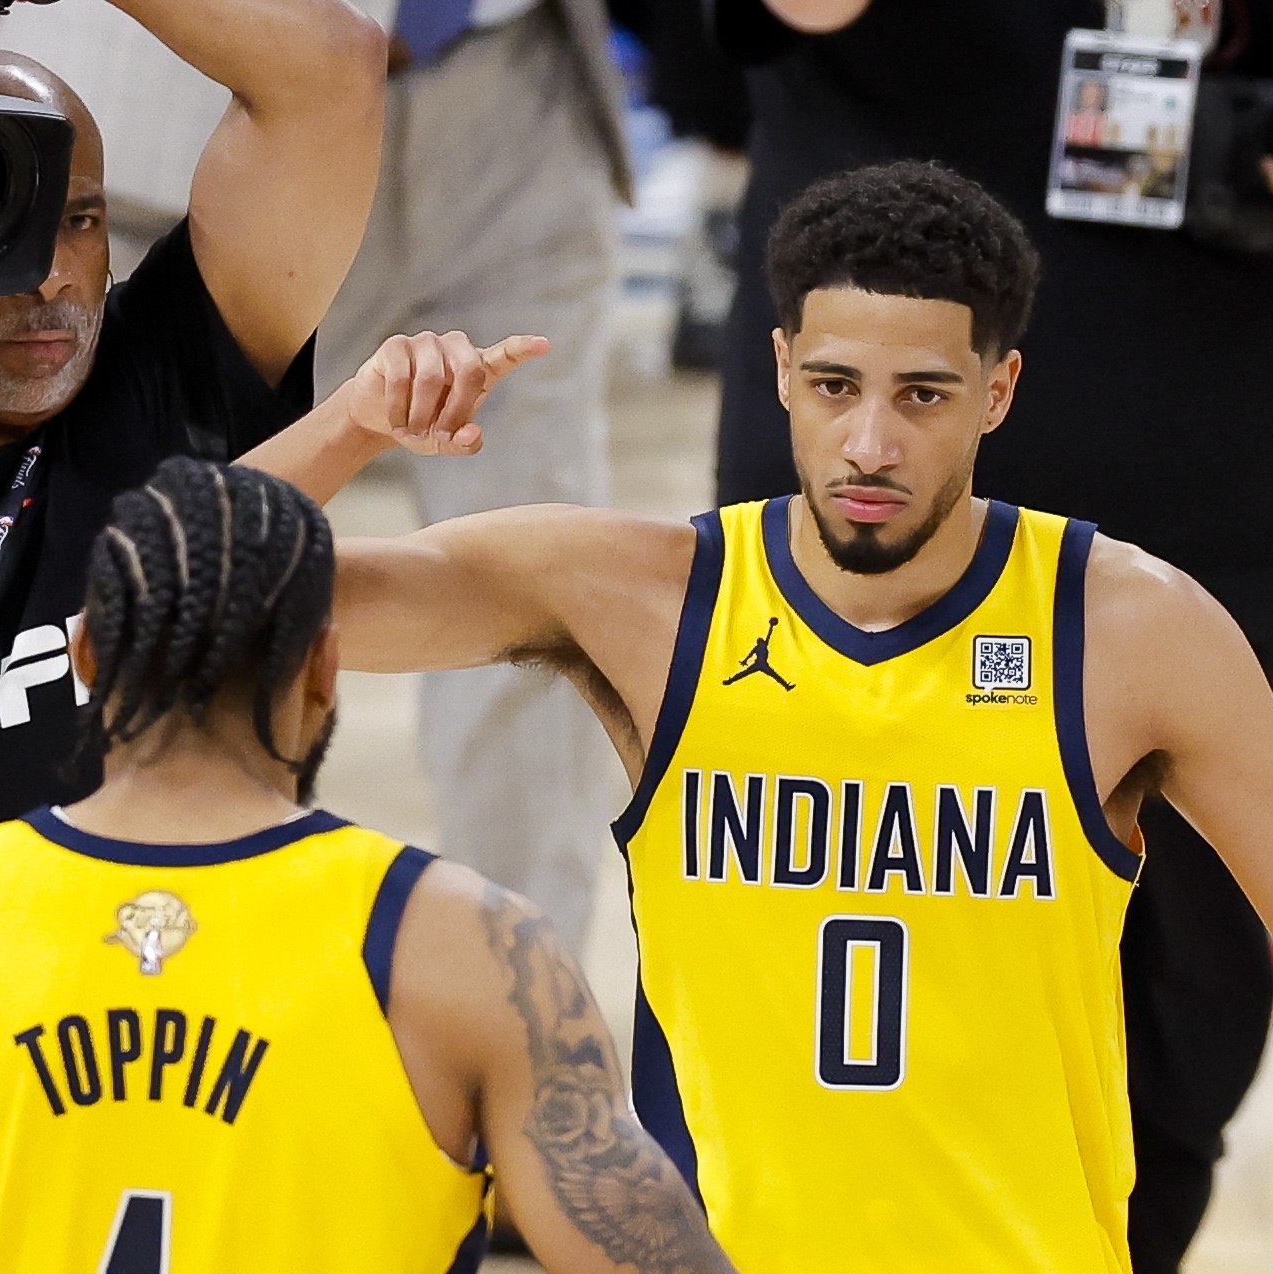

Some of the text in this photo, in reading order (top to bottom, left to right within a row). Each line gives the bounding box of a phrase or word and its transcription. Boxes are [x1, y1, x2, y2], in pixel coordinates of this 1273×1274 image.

[965, 691, 1038, 706] spokenote
[681, 767, 1056, 901] INDIANA
[814, 913, 910, 1092] 0
[14, 1007, 270, 1126] TOPPIN
